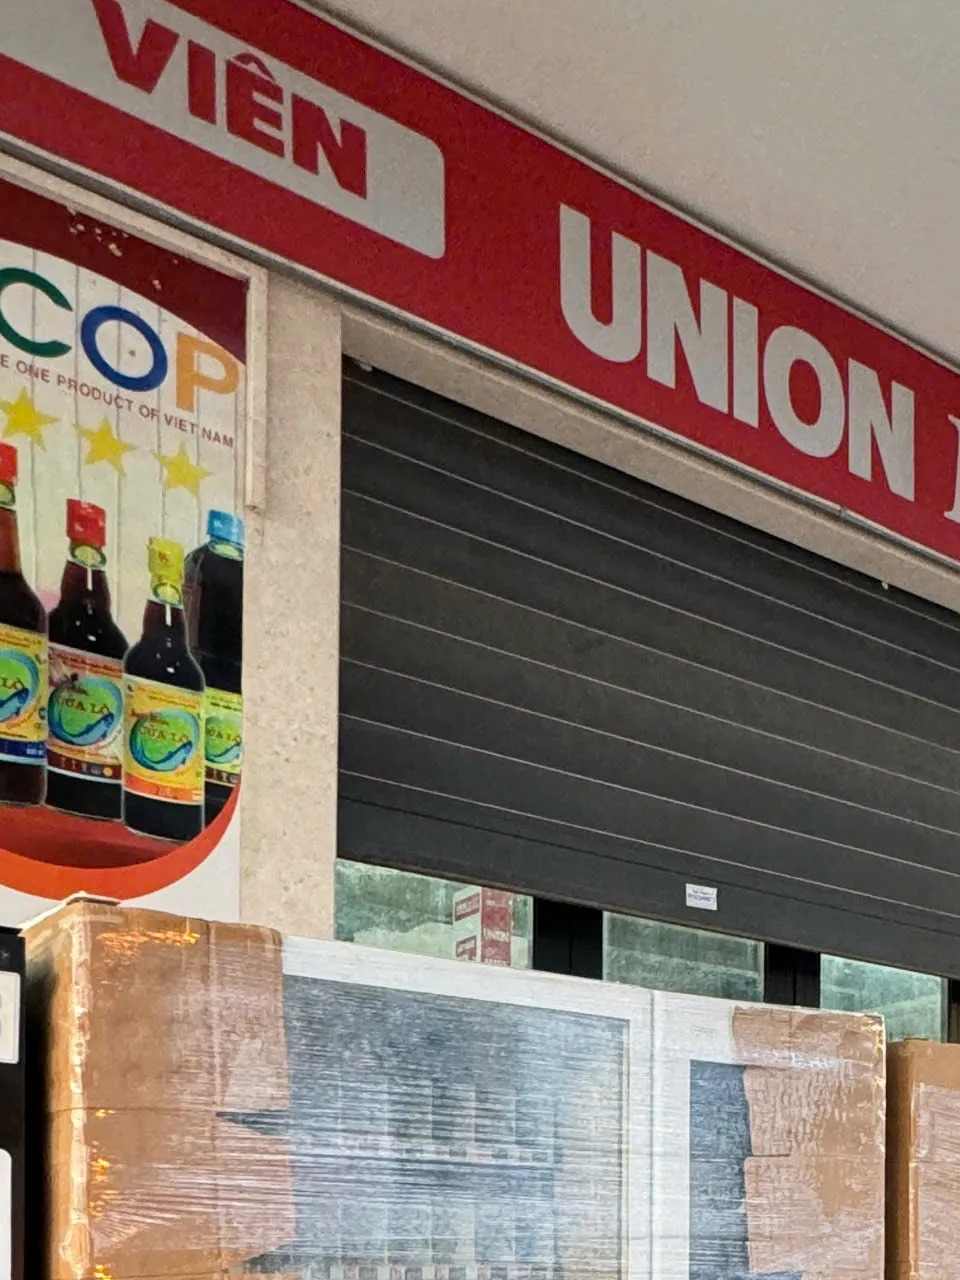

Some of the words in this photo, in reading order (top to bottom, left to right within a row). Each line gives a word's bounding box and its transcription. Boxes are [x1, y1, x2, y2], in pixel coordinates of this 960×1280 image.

[93, 0, 367, 199] VIÊN
[16, 360, 50, 383] ONE
[57, 374, 134, 412] PRODUCT
[139, 405, 159, 421] OF
[164, 412, 199, 435] VIET
[202, 426, 234, 449] NAM
[560, 202, 915, 502] UNION
